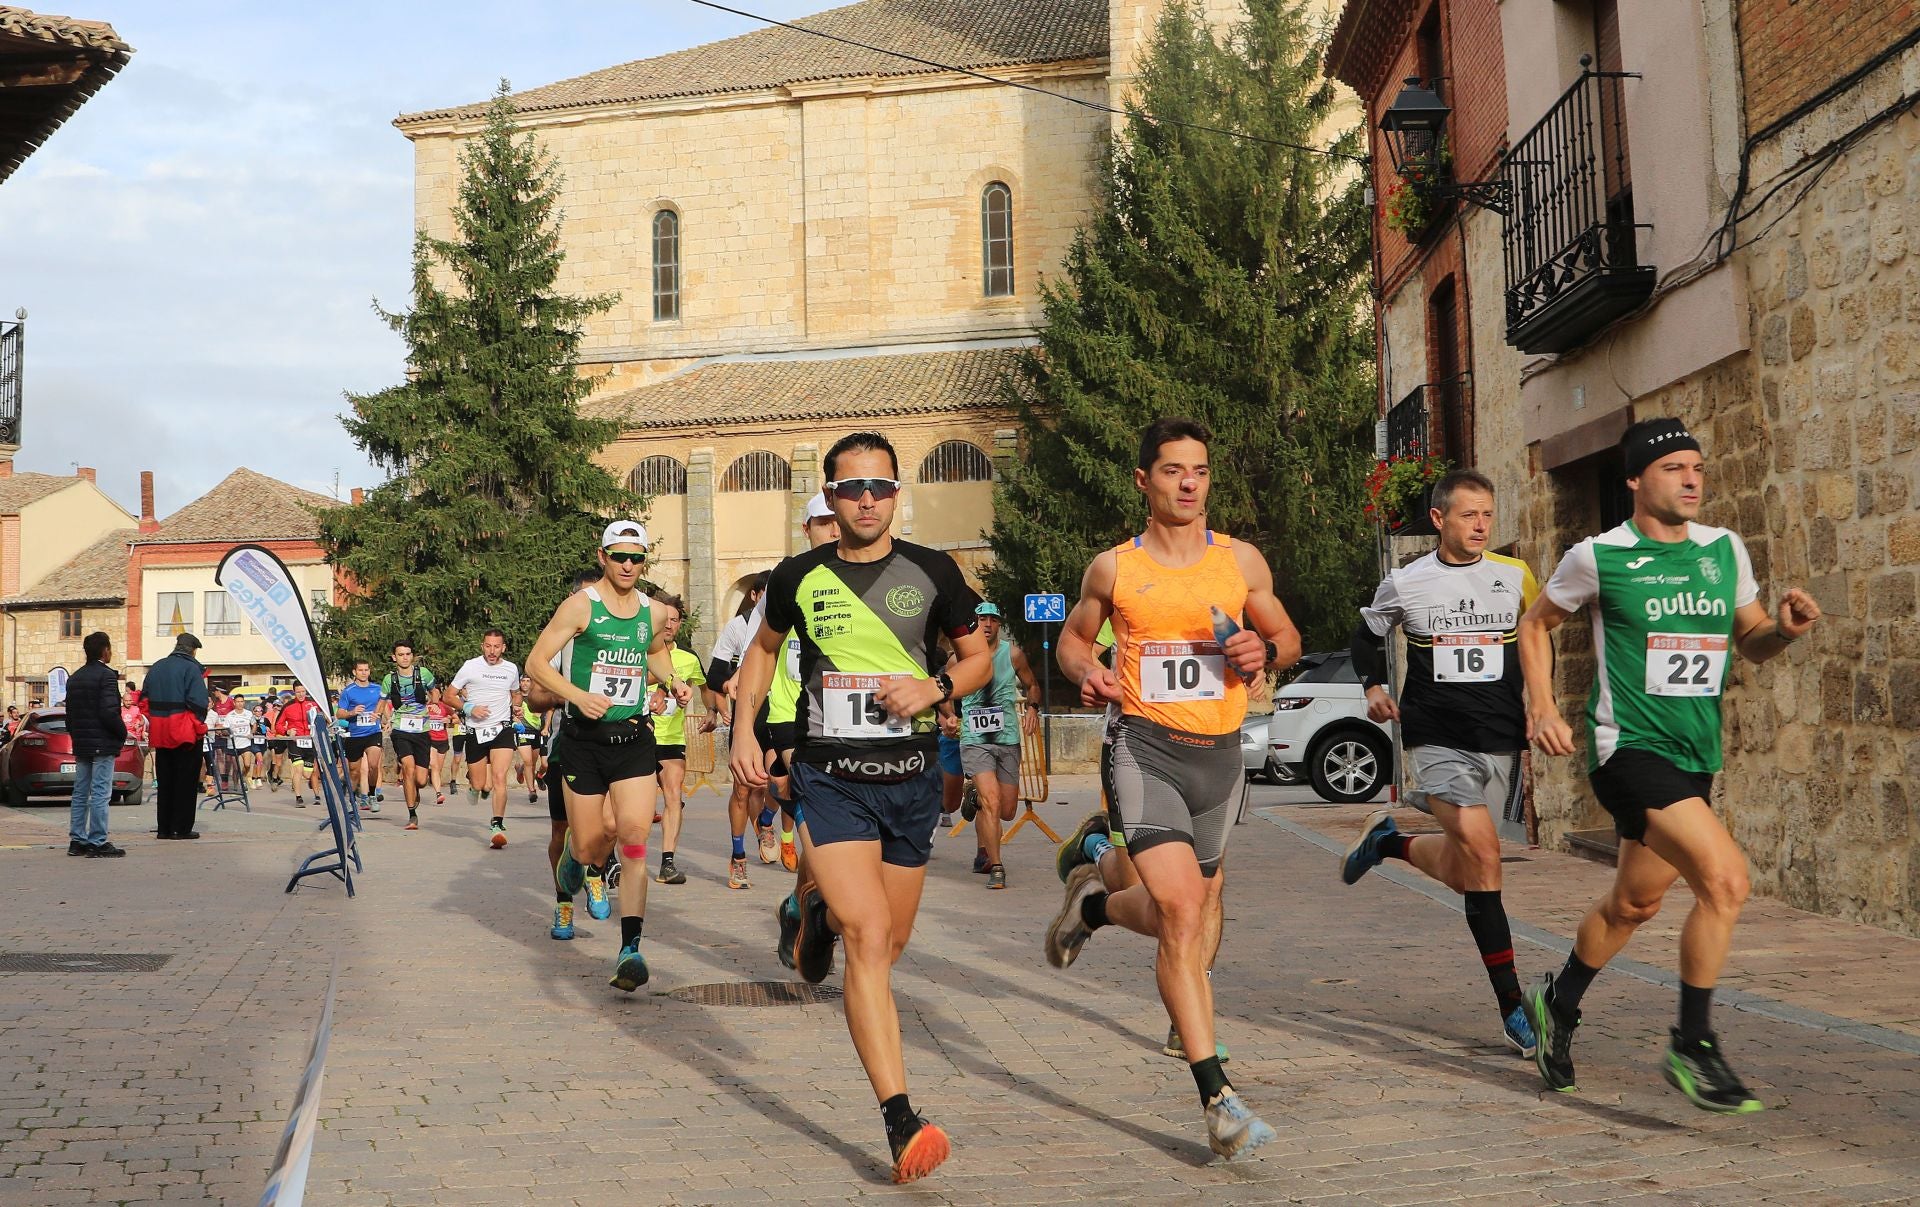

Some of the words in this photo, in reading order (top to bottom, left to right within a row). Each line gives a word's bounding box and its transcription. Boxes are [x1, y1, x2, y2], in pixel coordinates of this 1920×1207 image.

[1644, 591, 1727, 621] gullón
[813, 612, 852, 622] deportes
[597, 648, 642, 664] gullón
[1144, 645, 1167, 655] ASTU
[1170, 644, 1195, 655] TRAIL
[1453, 648, 1485, 673] 16
[1162, 659, 1200, 691] 10
[1667, 653, 1710, 684] 22
[603, 676, 633, 699] 37
[827, 676, 851, 688] ASTU
[847, 693, 888, 726] 15
[408, 719, 415, 727] 4
[972, 714, 1000, 729] 104
[482, 727, 498, 738] 43
[1168, 732, 1216, 746] WONG
